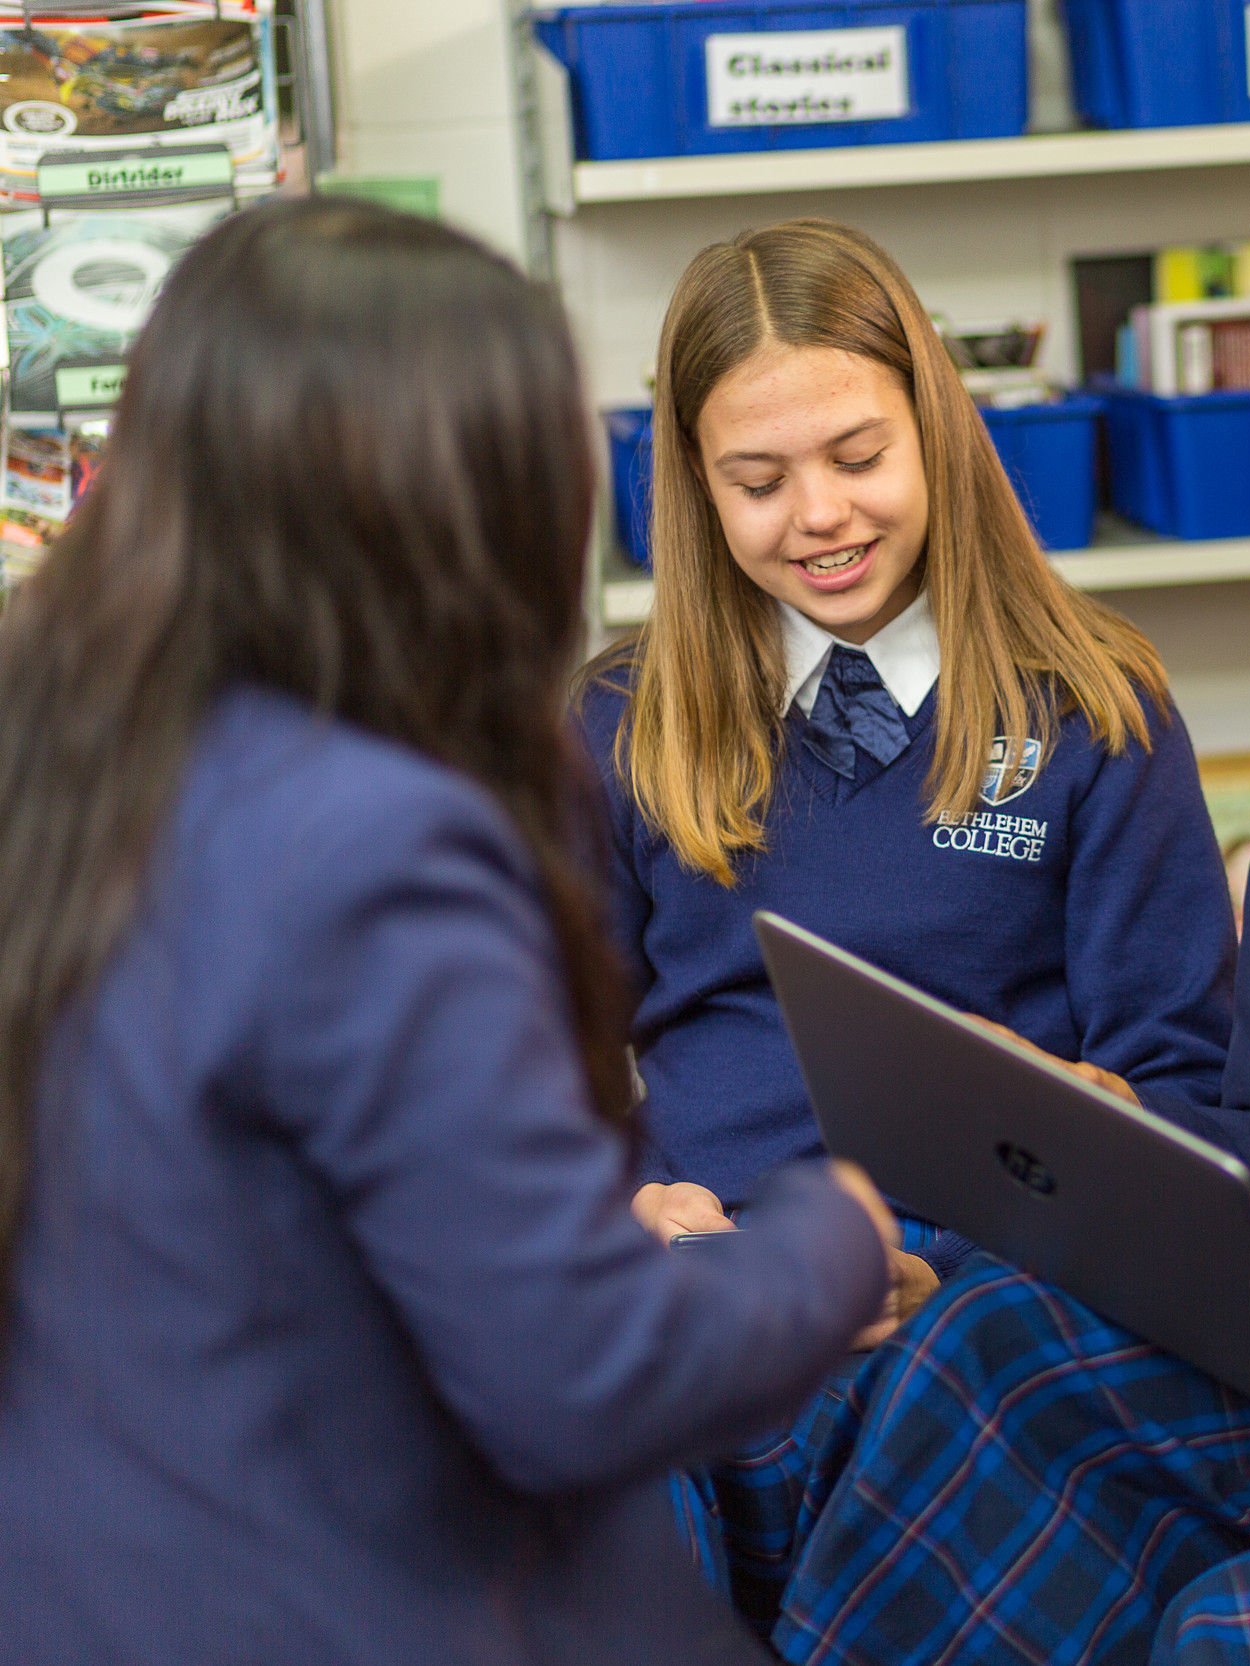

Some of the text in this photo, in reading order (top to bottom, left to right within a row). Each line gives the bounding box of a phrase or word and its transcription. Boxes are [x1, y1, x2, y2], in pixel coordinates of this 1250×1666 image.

[728, 48, 890, 77] Classical
[87, 165, 184, 187] Dirtrider
[937, 810, 1048, 838] BETHLEHEM
[933, 826, 1045, 861] COLLEGE
